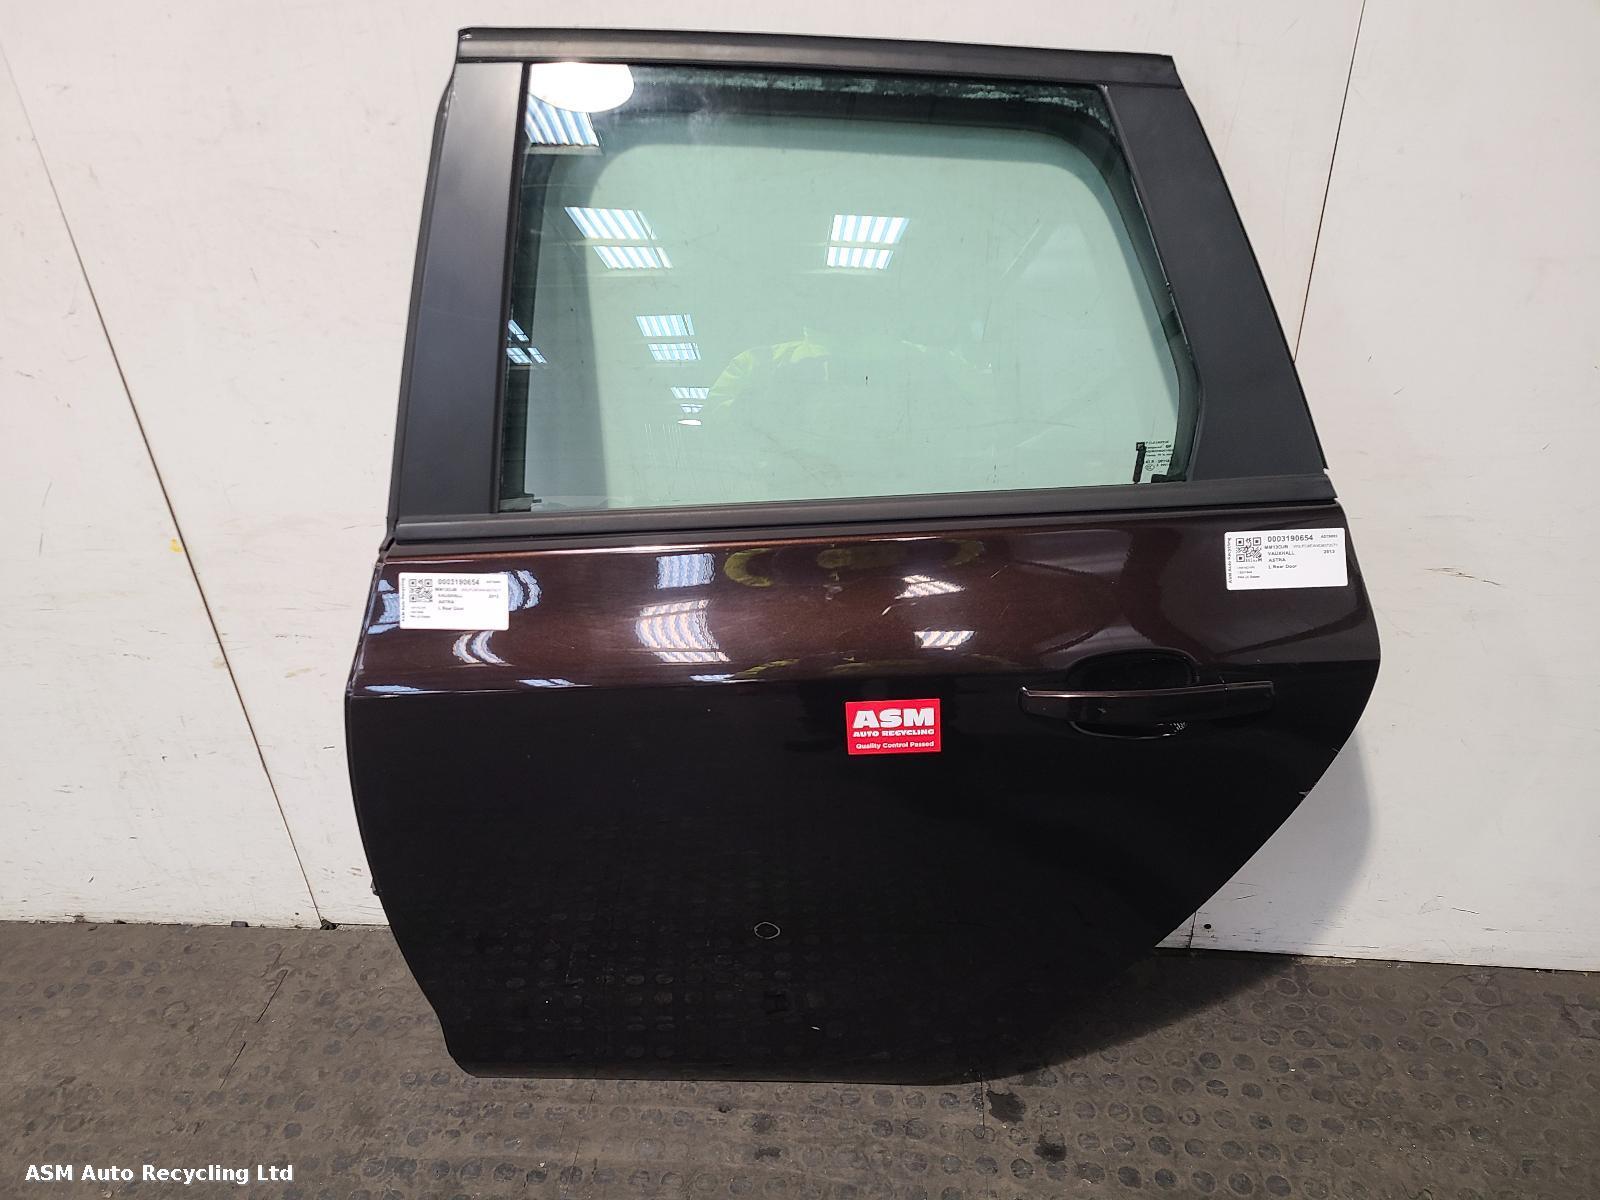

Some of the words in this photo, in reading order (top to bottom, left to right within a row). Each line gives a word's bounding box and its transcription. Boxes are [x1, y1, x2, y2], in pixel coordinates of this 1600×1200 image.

[1267, 534, 1313, 542] 0003190654
[852, 707, 935, 729] ASM
[853, 730, 879, 738] AUTO
[881, 729, 935, 737] RECYCLING
[855, 742, 881, 750] Quality
[909, 740, 934, 748] Passed
